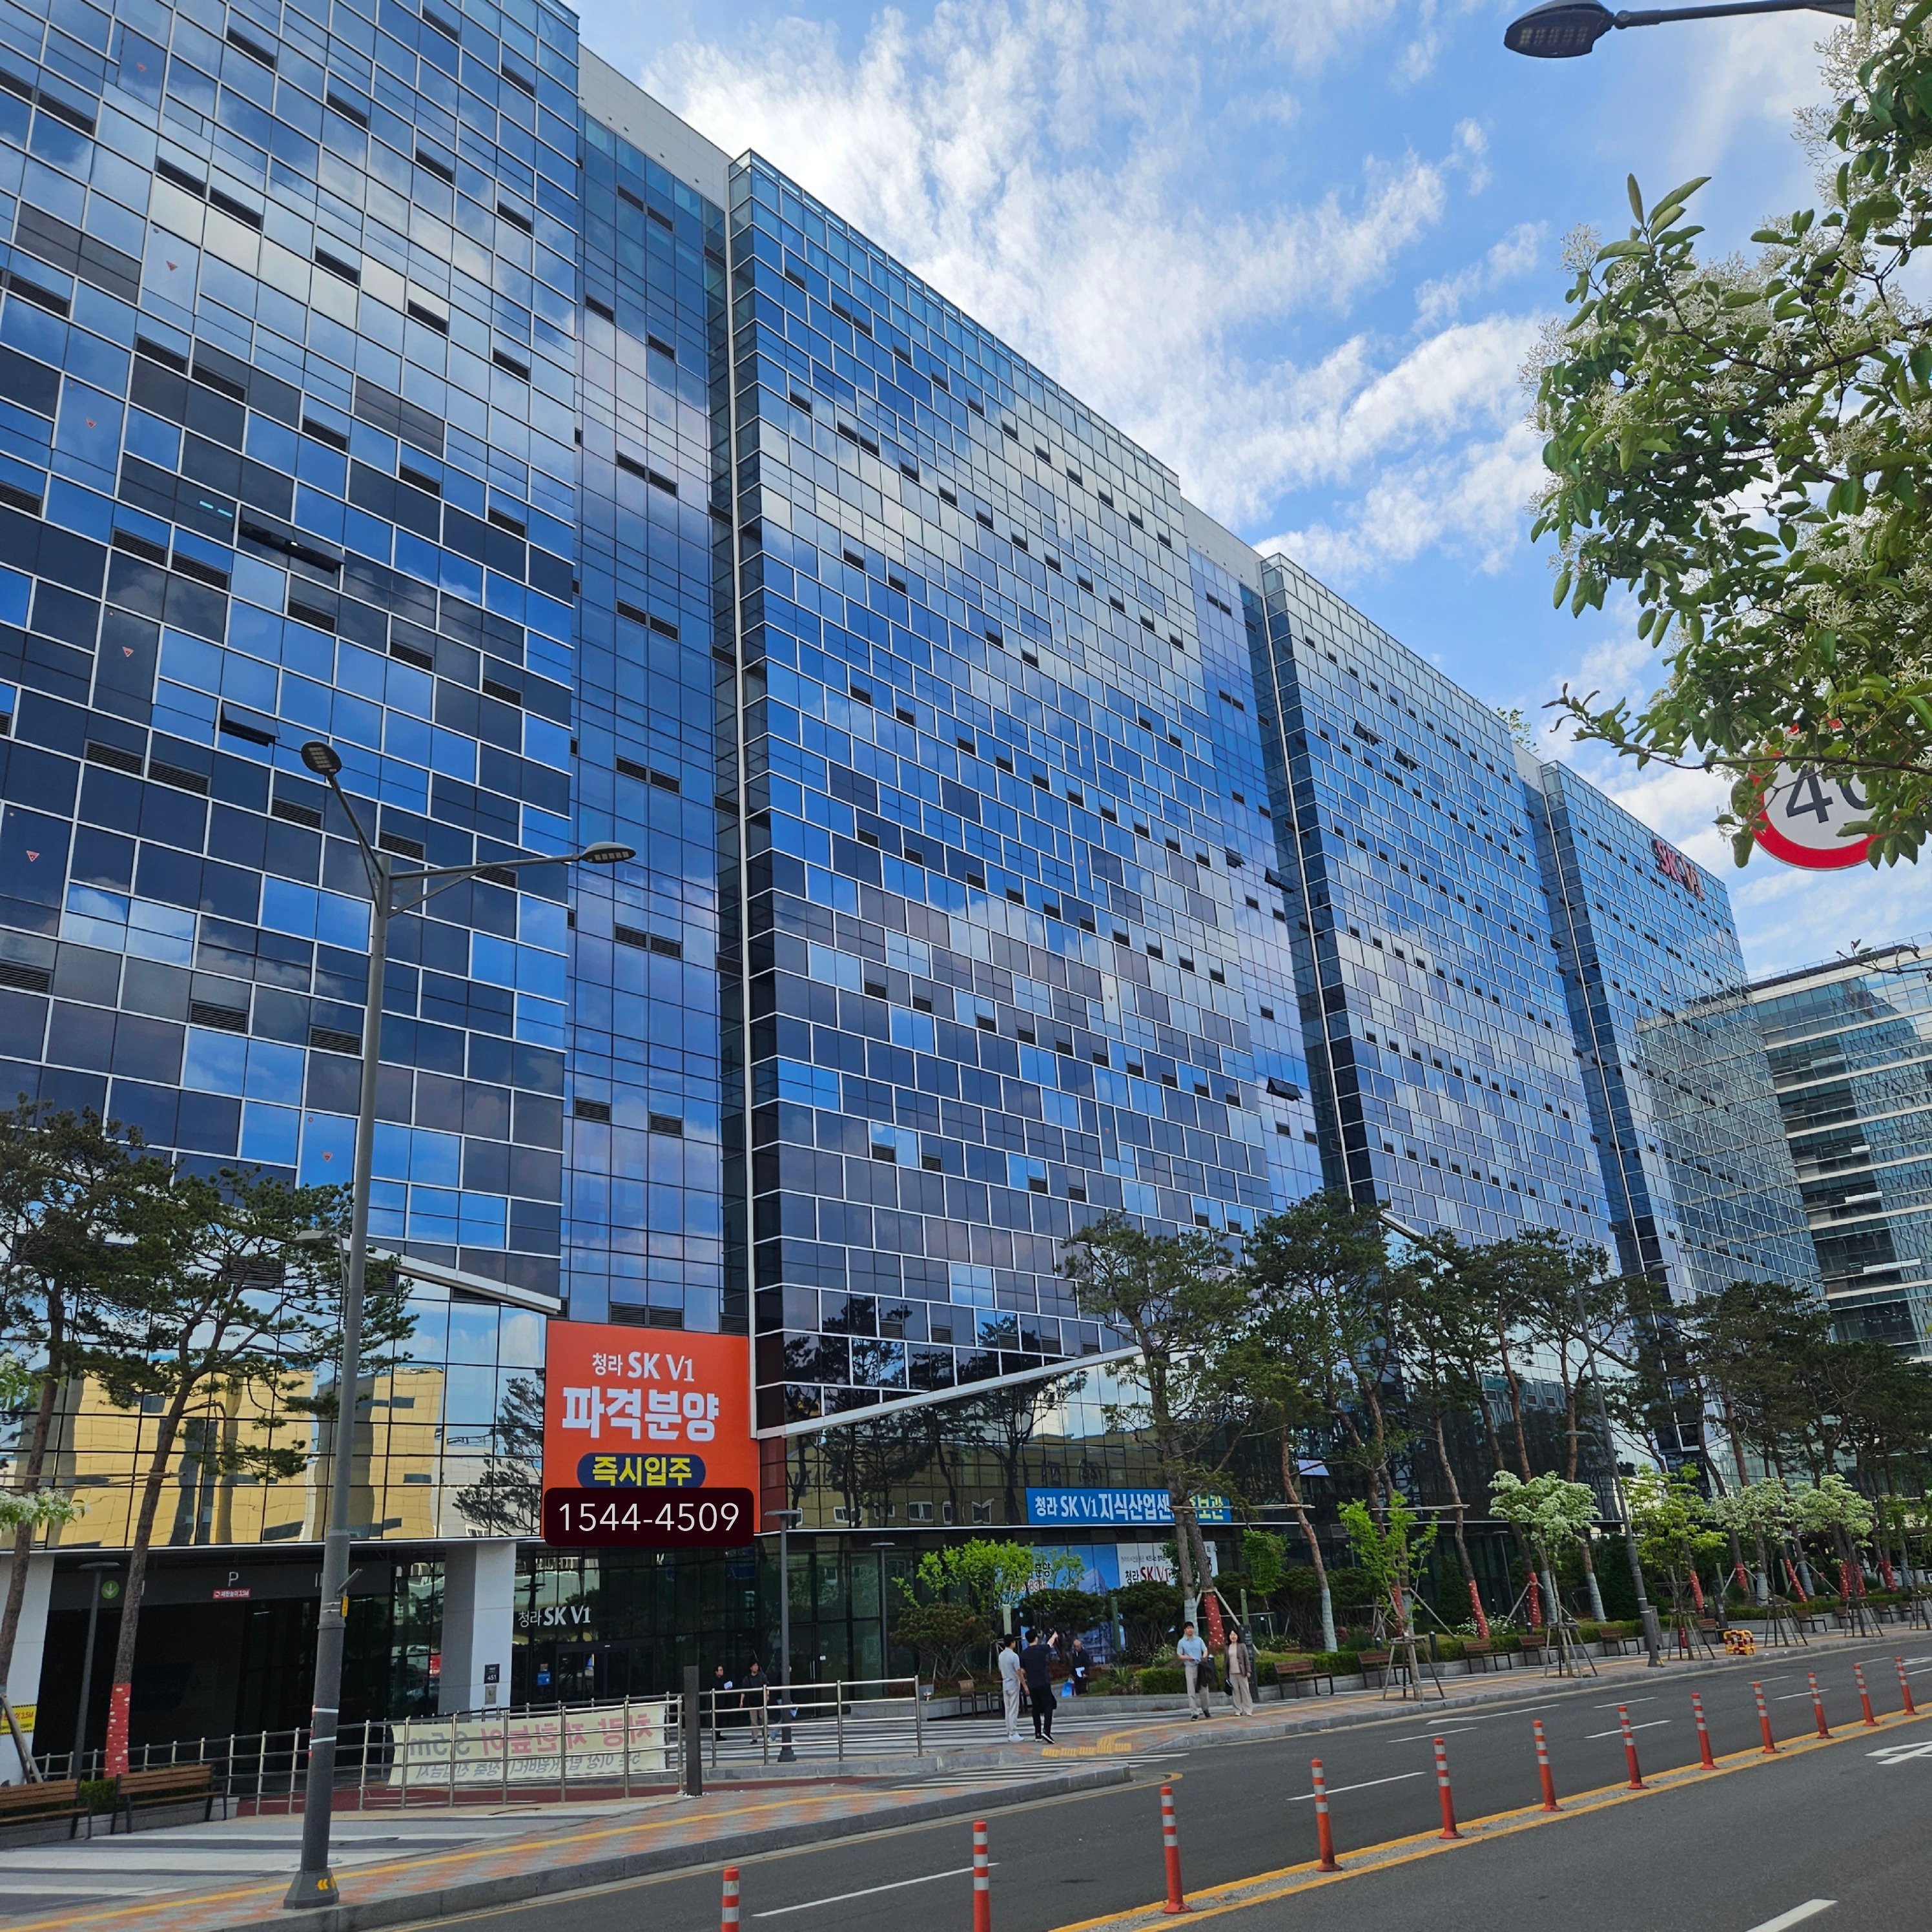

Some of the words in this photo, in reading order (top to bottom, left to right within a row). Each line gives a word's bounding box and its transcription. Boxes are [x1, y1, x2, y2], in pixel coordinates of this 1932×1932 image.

[592, 1353, 623, 1377] 청라
[627, 1351, 661, 1380] SK
[666, 1353, 695, 1382] V1
[562, 1386, 719, 1442] 파격분양
[592, 1456, 692, 1486] 즉시입주
[1034, 1496, 1058, 1517] 청라
[1060, 1495, 1079, 1517] SK
[1098, 1493, 1175, 1521] 지식산업센
[228, 1571, 239, 1587] P
[1125, 1569, 1140, 1585] 청라
[1140, 1566, 1154, 1581] SK
[518, 1610, 542, 1627] 청라
[542, 1606, 567, 1626] SK
[570, 1605, 591, 1624] V1
